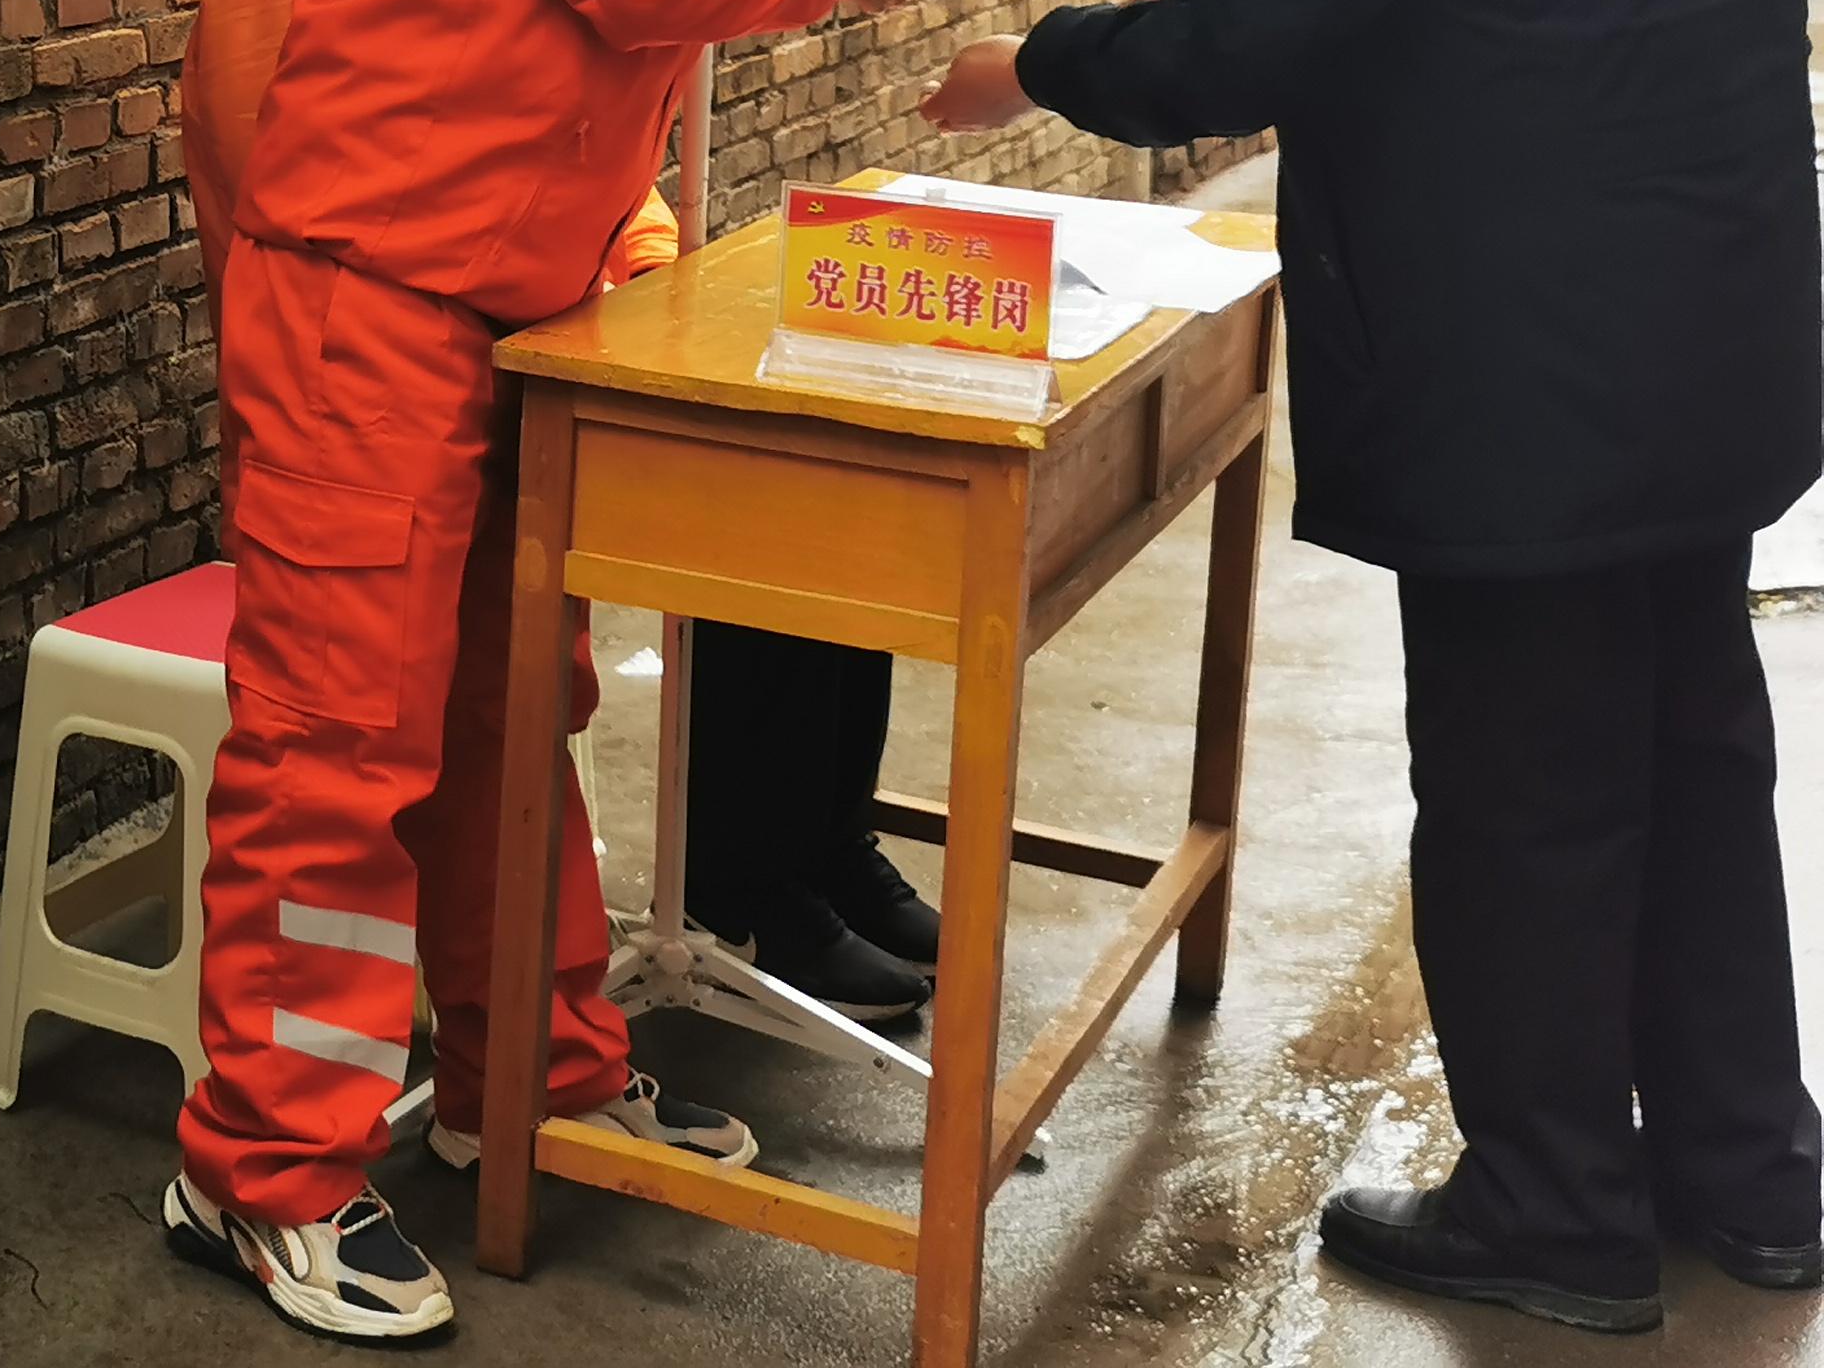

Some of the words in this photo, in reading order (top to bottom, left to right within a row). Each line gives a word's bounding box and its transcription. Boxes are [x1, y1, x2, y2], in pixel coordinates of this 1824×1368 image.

[846, 222, 994, 261] 疫情防控
[805, 256, 1032, 334] 党员先锋岗
